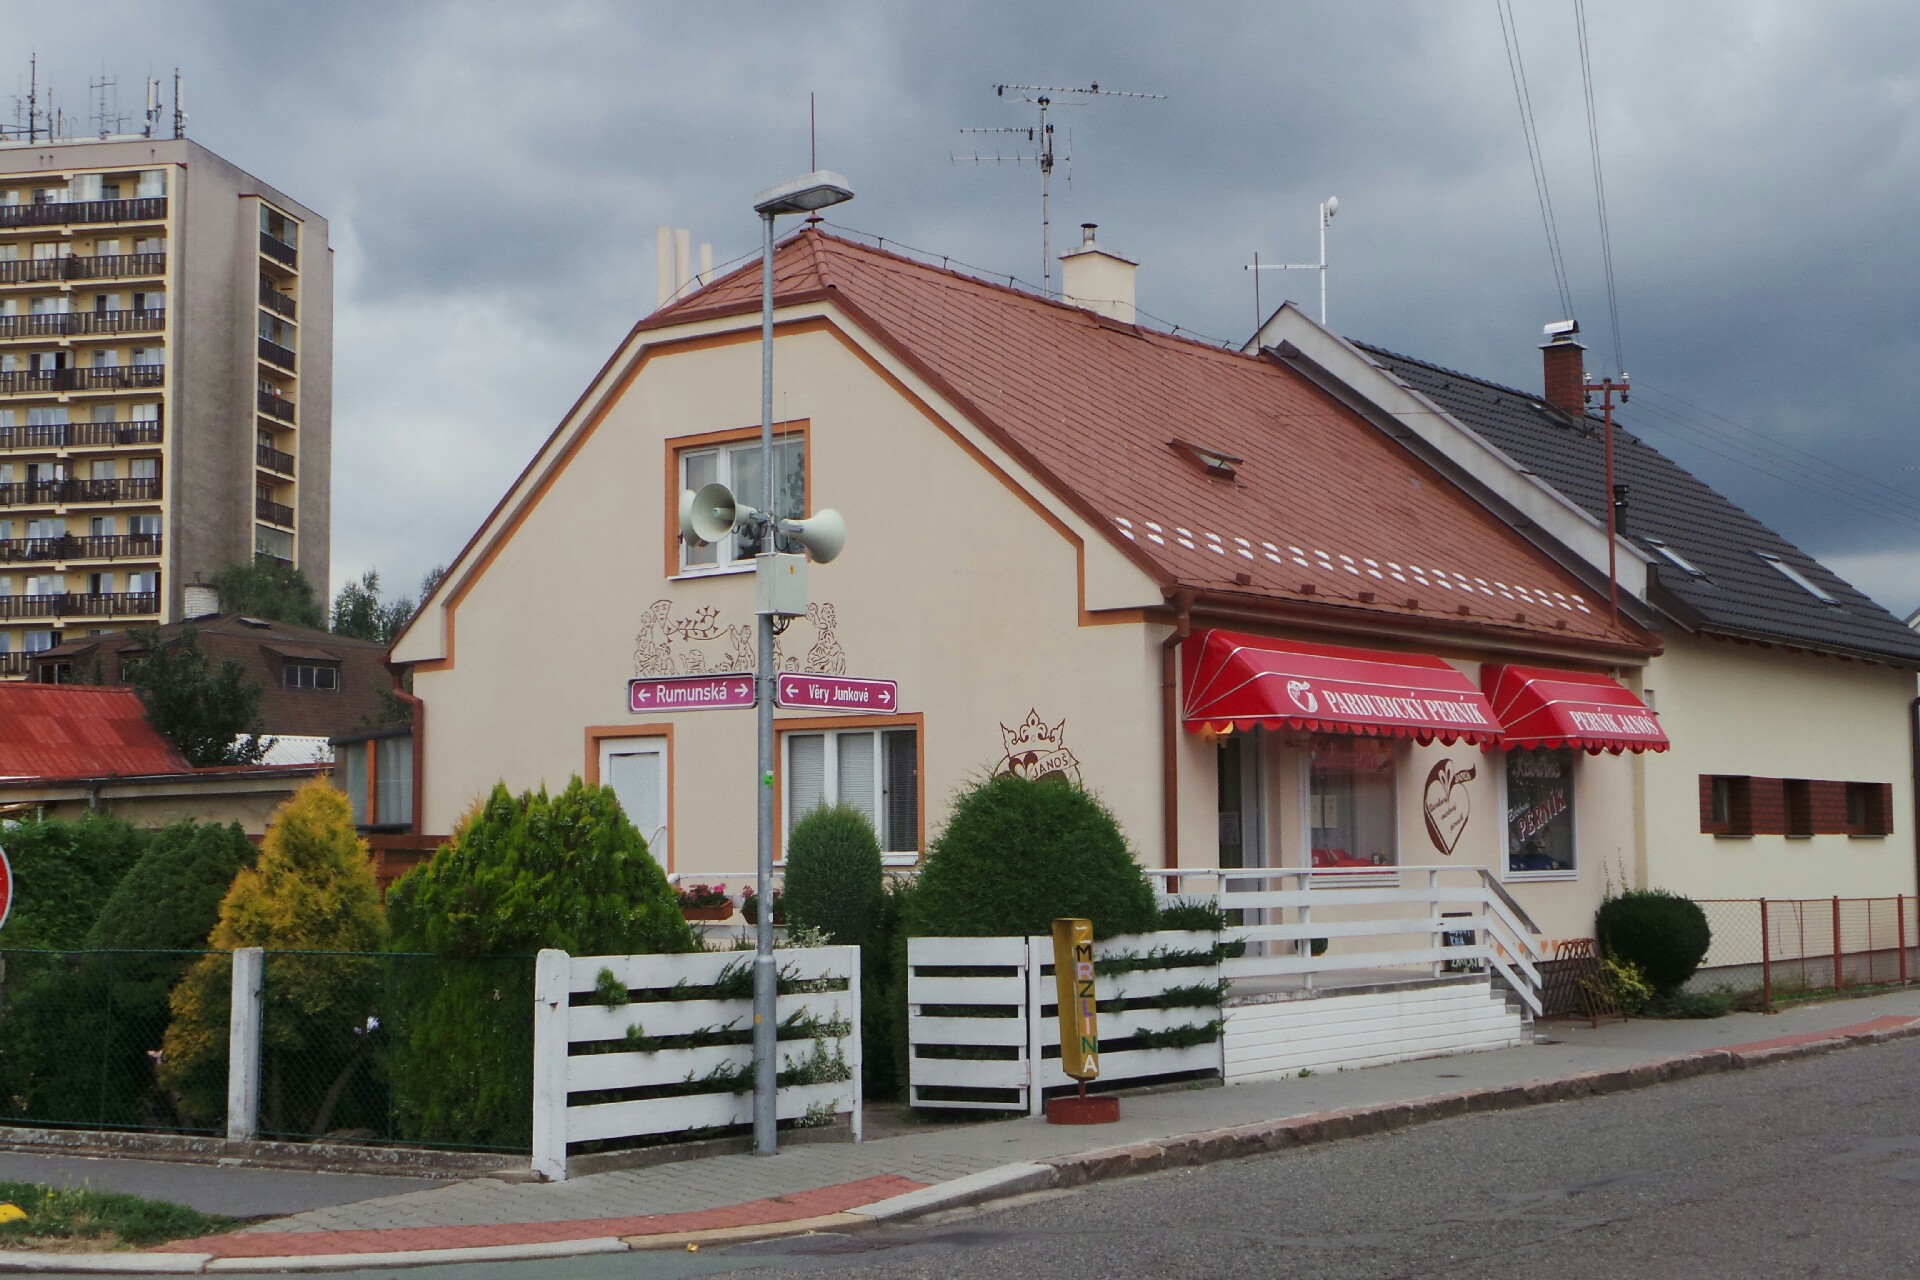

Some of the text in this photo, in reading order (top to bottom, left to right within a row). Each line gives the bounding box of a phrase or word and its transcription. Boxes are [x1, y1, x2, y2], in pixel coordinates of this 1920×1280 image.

[656, 682, 727, 703] Rumunská
[808, 683, 869, 704] Věry Junkové
[1321, 690, 1489, 725] PARDUBICKÝ PERNÍK
[1568, 706, 1660, 736] PERNÍK JANOŠ
[1033, 752, 1069, 779] JANOŠ
[1518, 788, 1567, 842] PERNÍK
[1074, 925, 1099, 1074] ZMRZLINA
